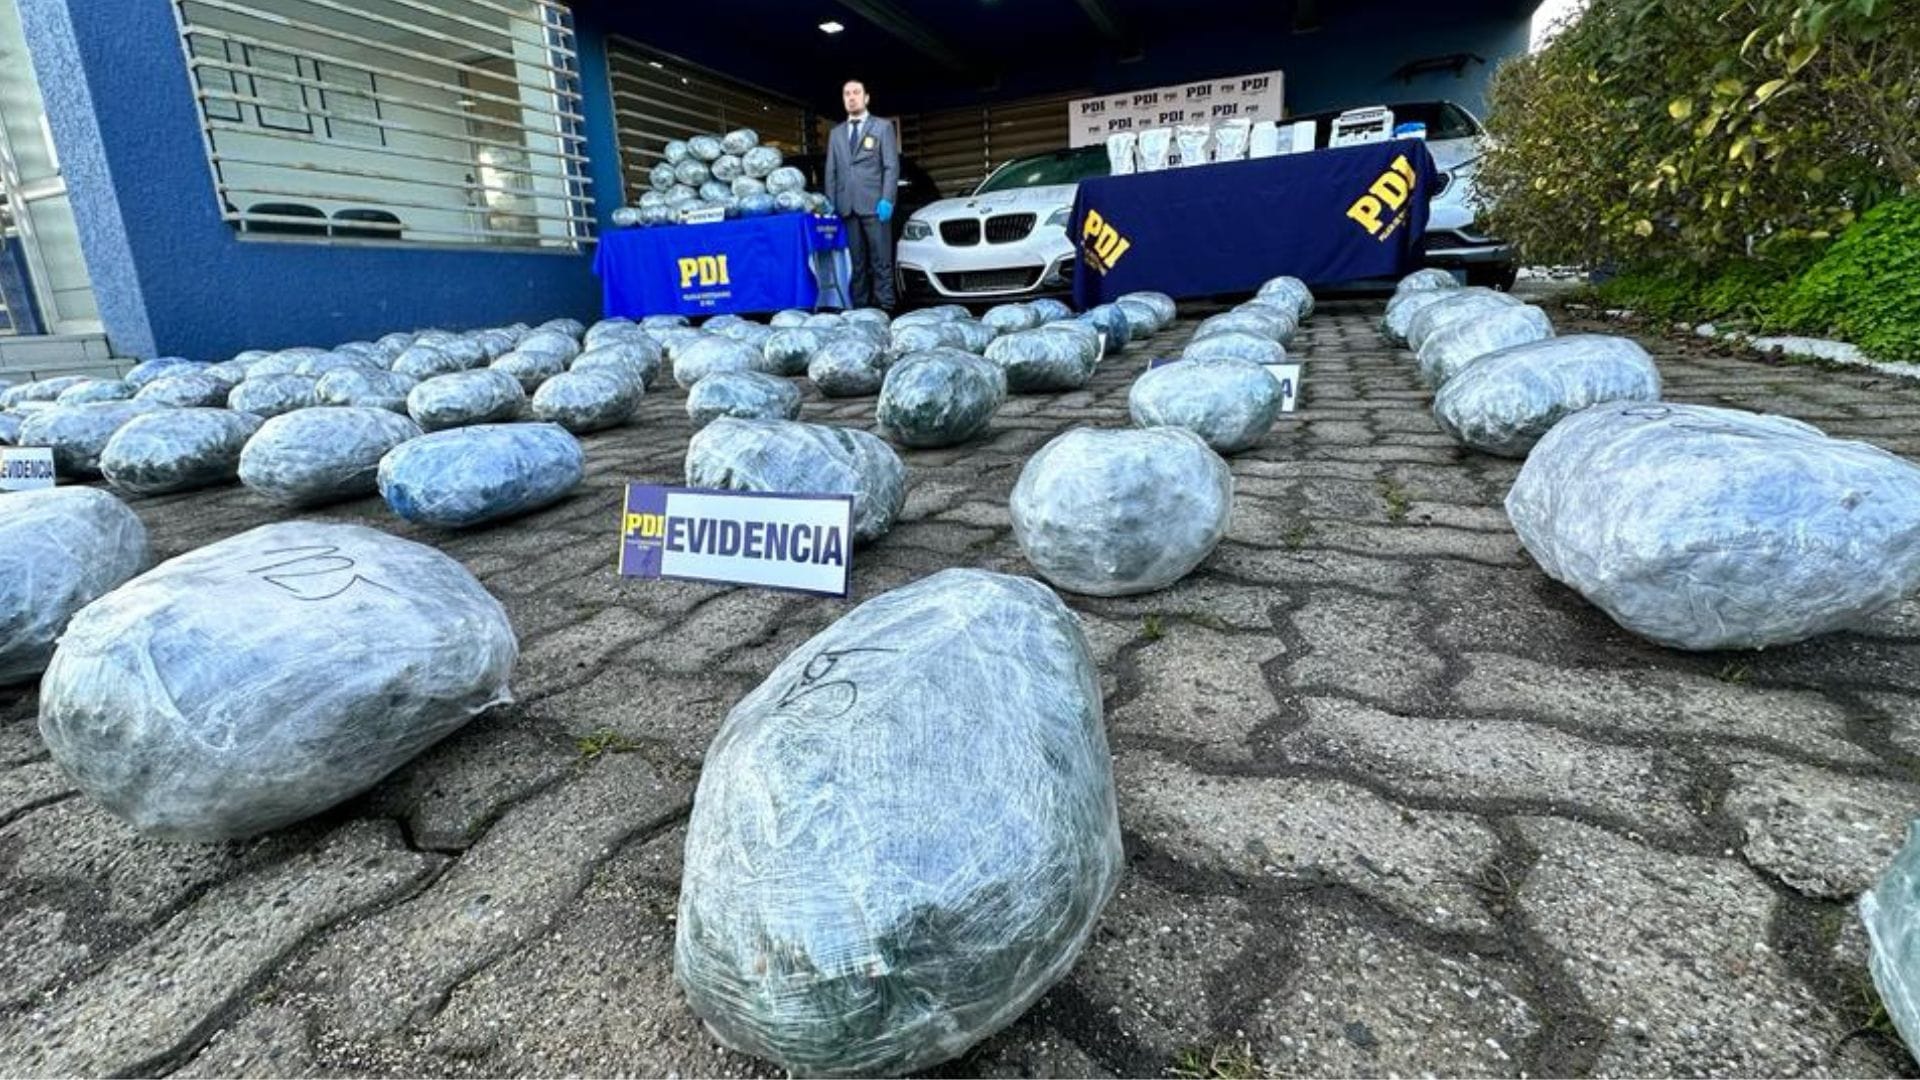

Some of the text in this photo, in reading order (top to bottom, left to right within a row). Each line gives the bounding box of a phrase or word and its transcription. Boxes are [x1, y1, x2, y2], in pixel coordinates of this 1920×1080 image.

[1082, 101, 1105, 114] PDI
[1133, 93, 1158, 106] PDI
[1186, 84, 1212, 97] PDI
[1241, 77, 1269, 91] PDI
[1108, 117, 1132, 130] PDI
[1159, 110, 1184, 123] PDI
[1212, 103, 1238, 116] PDI
[1346, 154, 1417, 235] PDI
[1081, 208, 1131, 269] PDI
[678, 254, 730, 288] PDI
[626, 512, 844, 567] PDI EVIDENCIA
